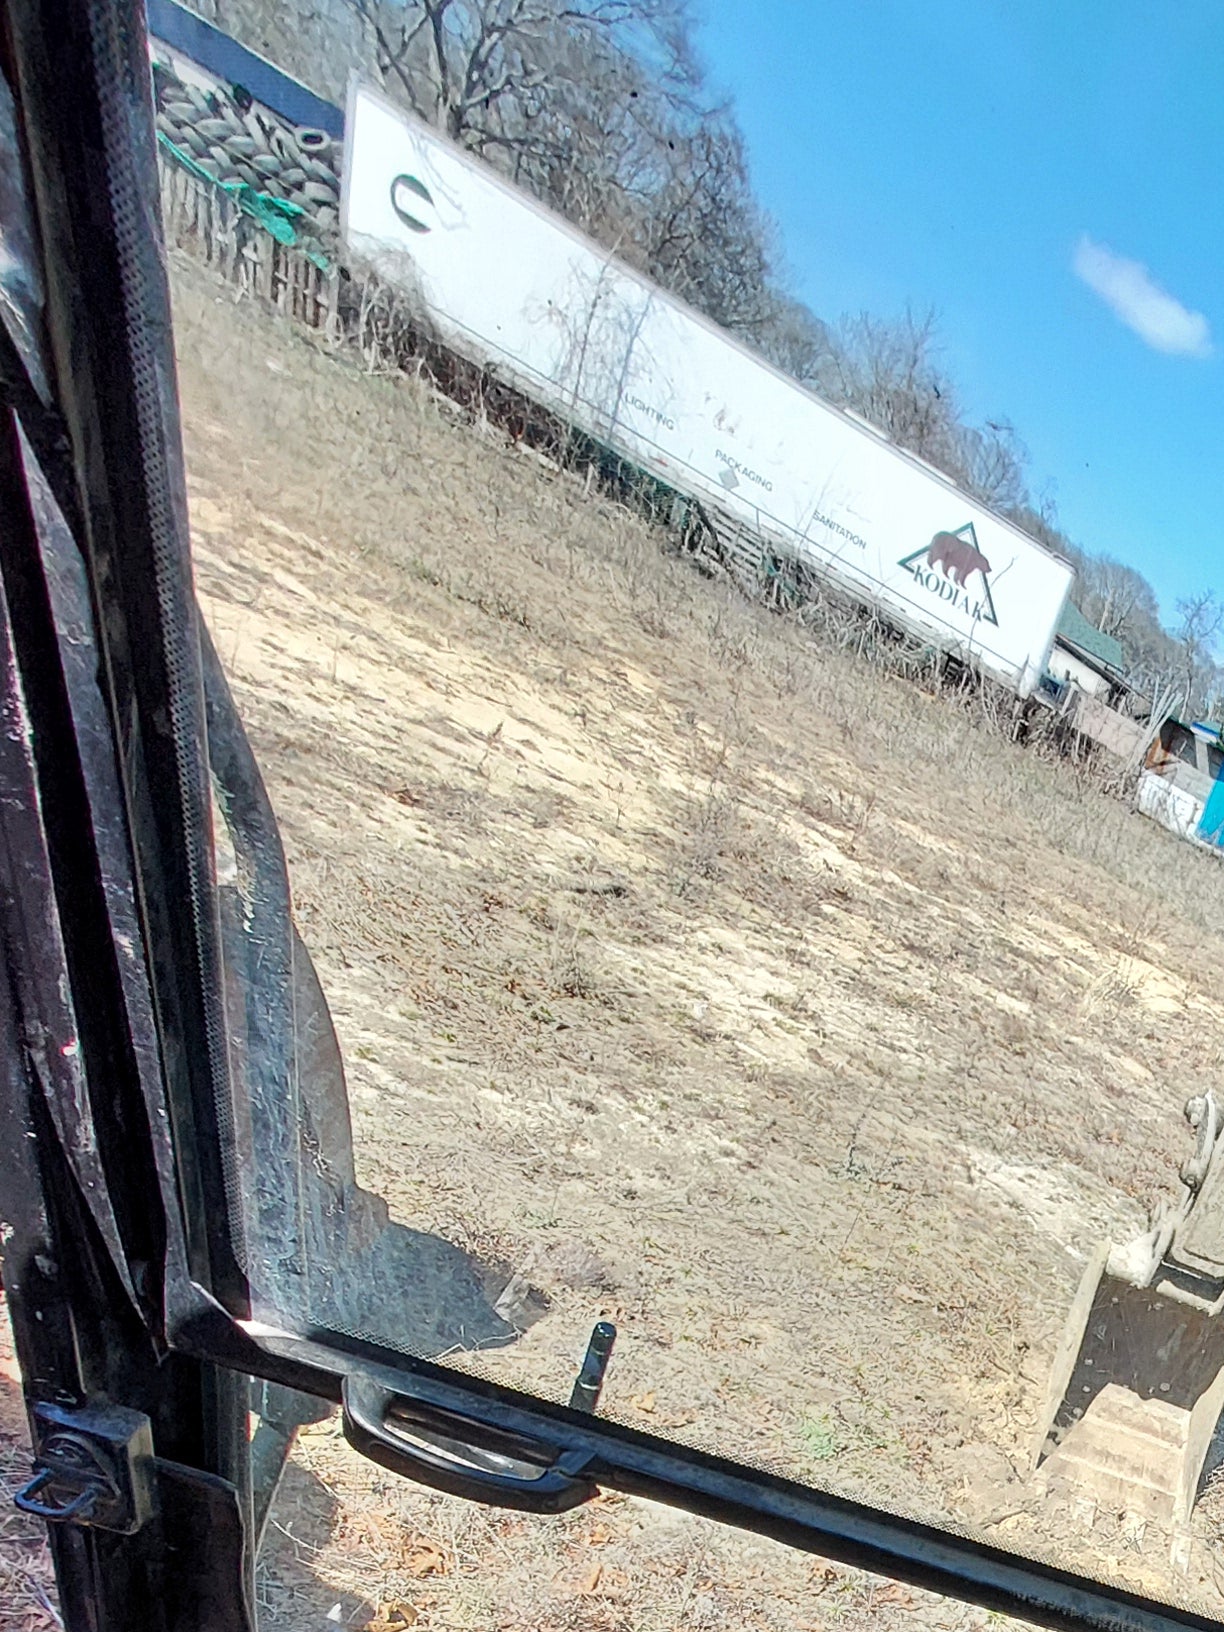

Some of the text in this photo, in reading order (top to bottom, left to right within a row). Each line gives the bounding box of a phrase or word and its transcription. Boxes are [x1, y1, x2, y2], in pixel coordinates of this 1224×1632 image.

[624, 393, 675, 430] LIGHTING
[715, 448, 774, 492] PACKAGING
[812, 510, 868, 550] SANITATION
[913, 564, 984, 622] KODIAK
